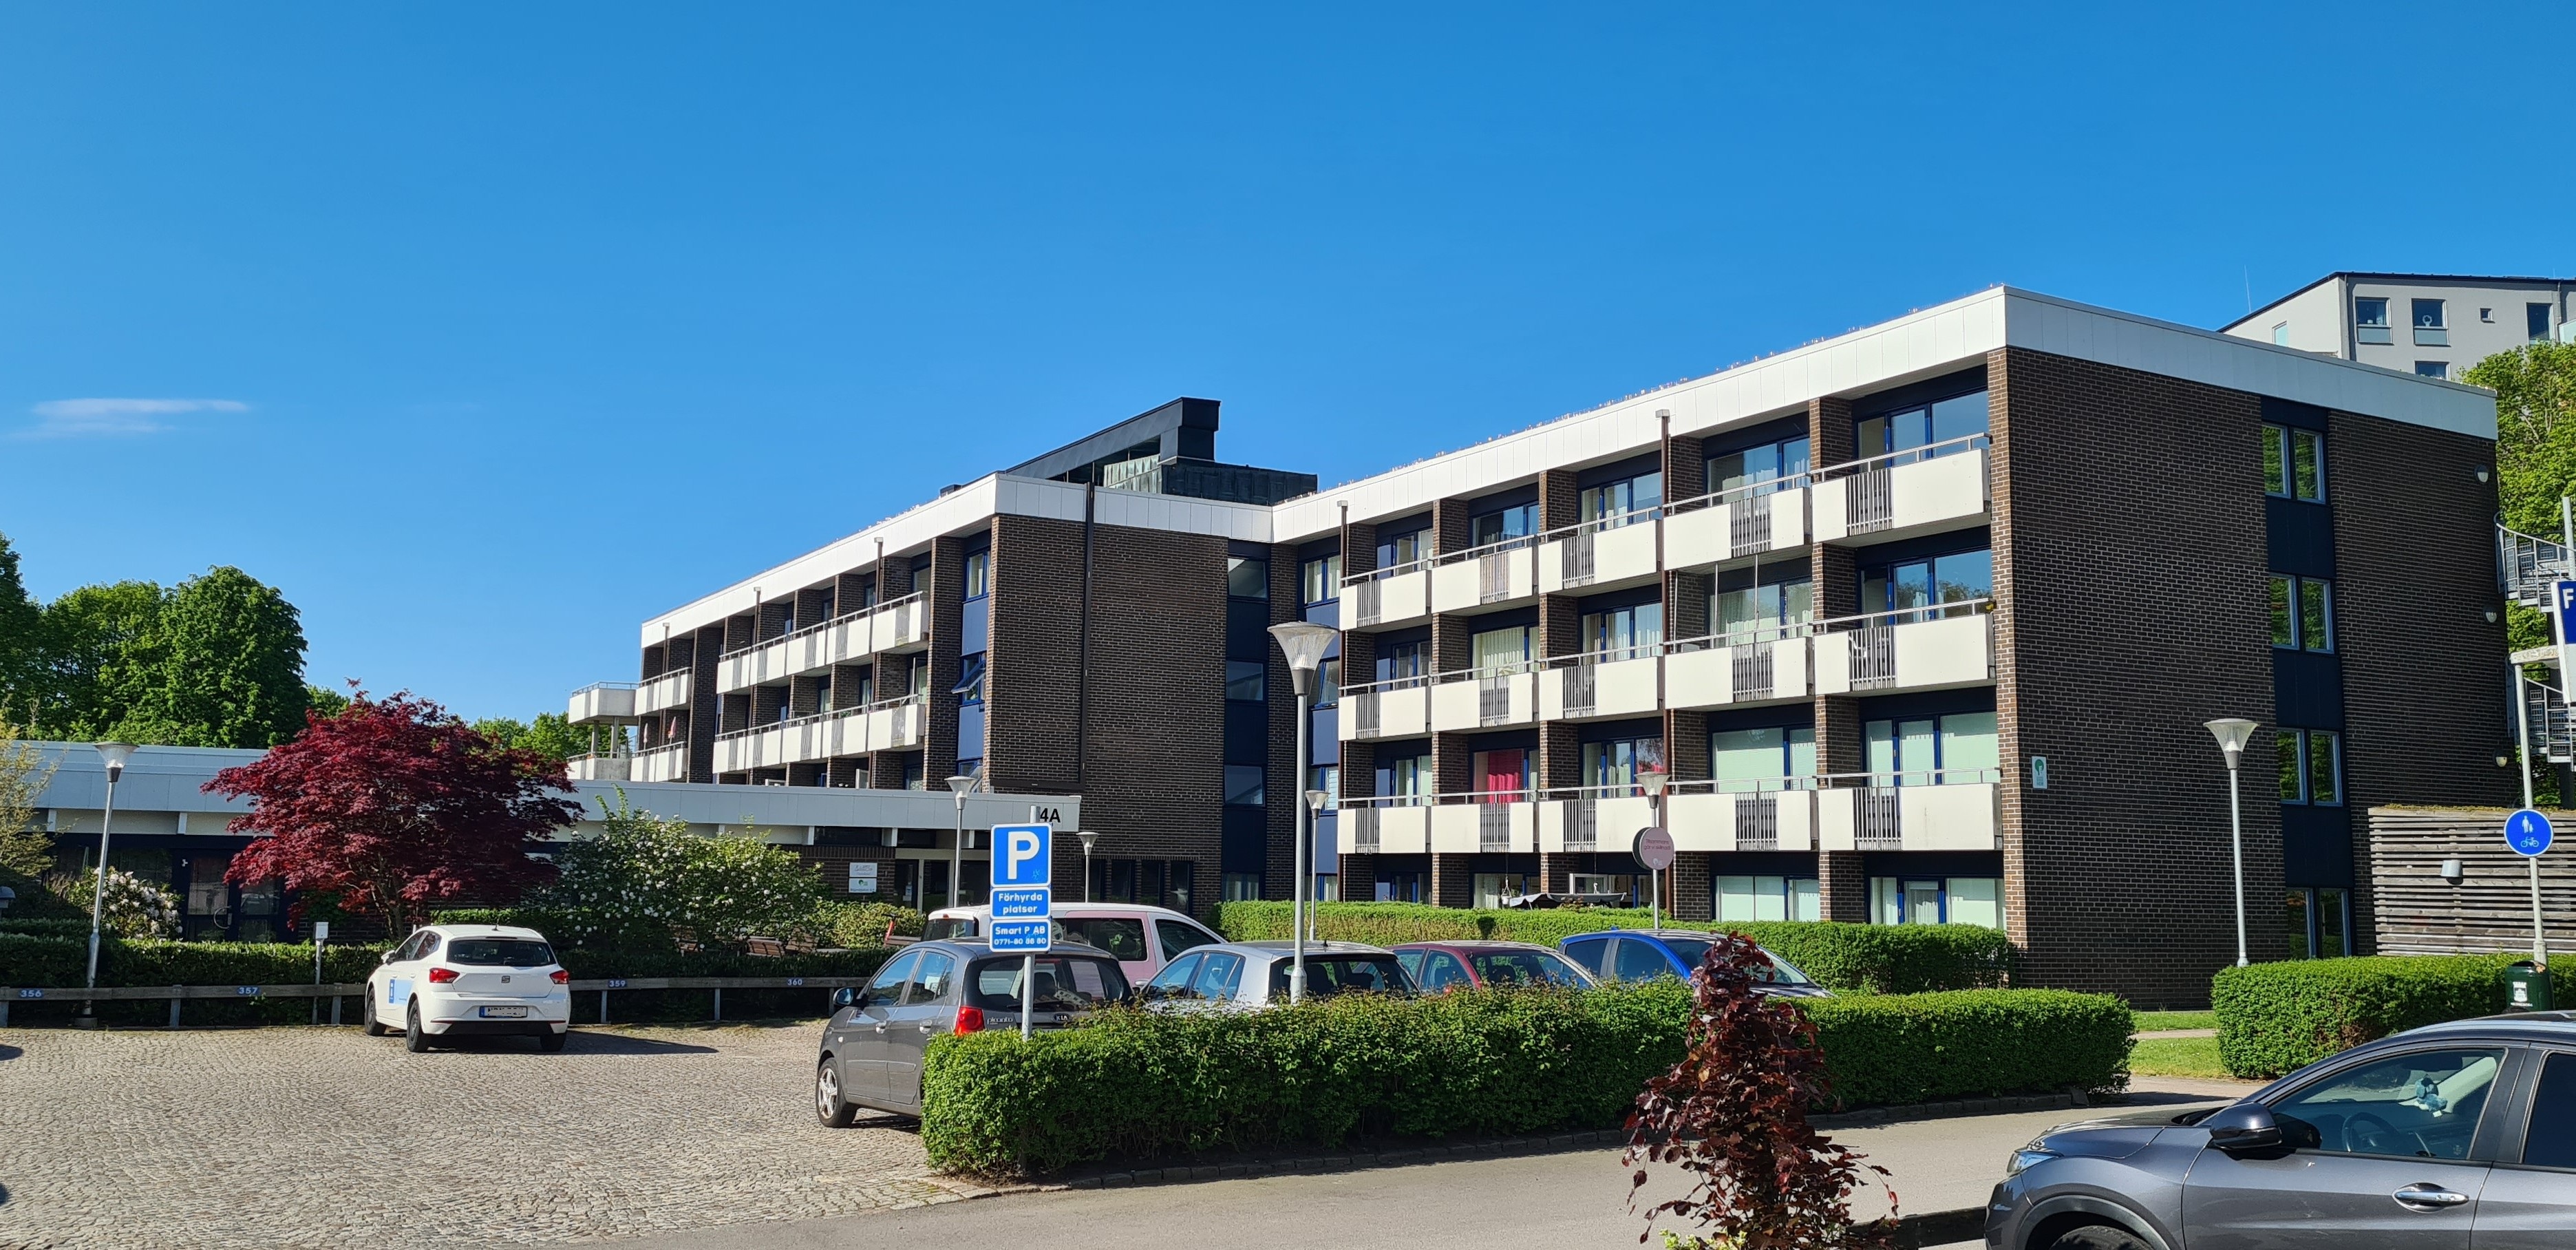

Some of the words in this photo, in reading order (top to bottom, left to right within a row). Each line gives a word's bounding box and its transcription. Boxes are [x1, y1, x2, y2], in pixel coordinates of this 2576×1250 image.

[1040, 807, 1061, 823] 4A
[1008, 831, 1040, 880] P
[999, 892, 1043, 903] Förhyrda
[1003, 904, 1037, 915] platser
[995, 926, 1021, 935] Smart
[1024, 926, 1030, 934] P
[1033, 925, 1045, 935] AB
